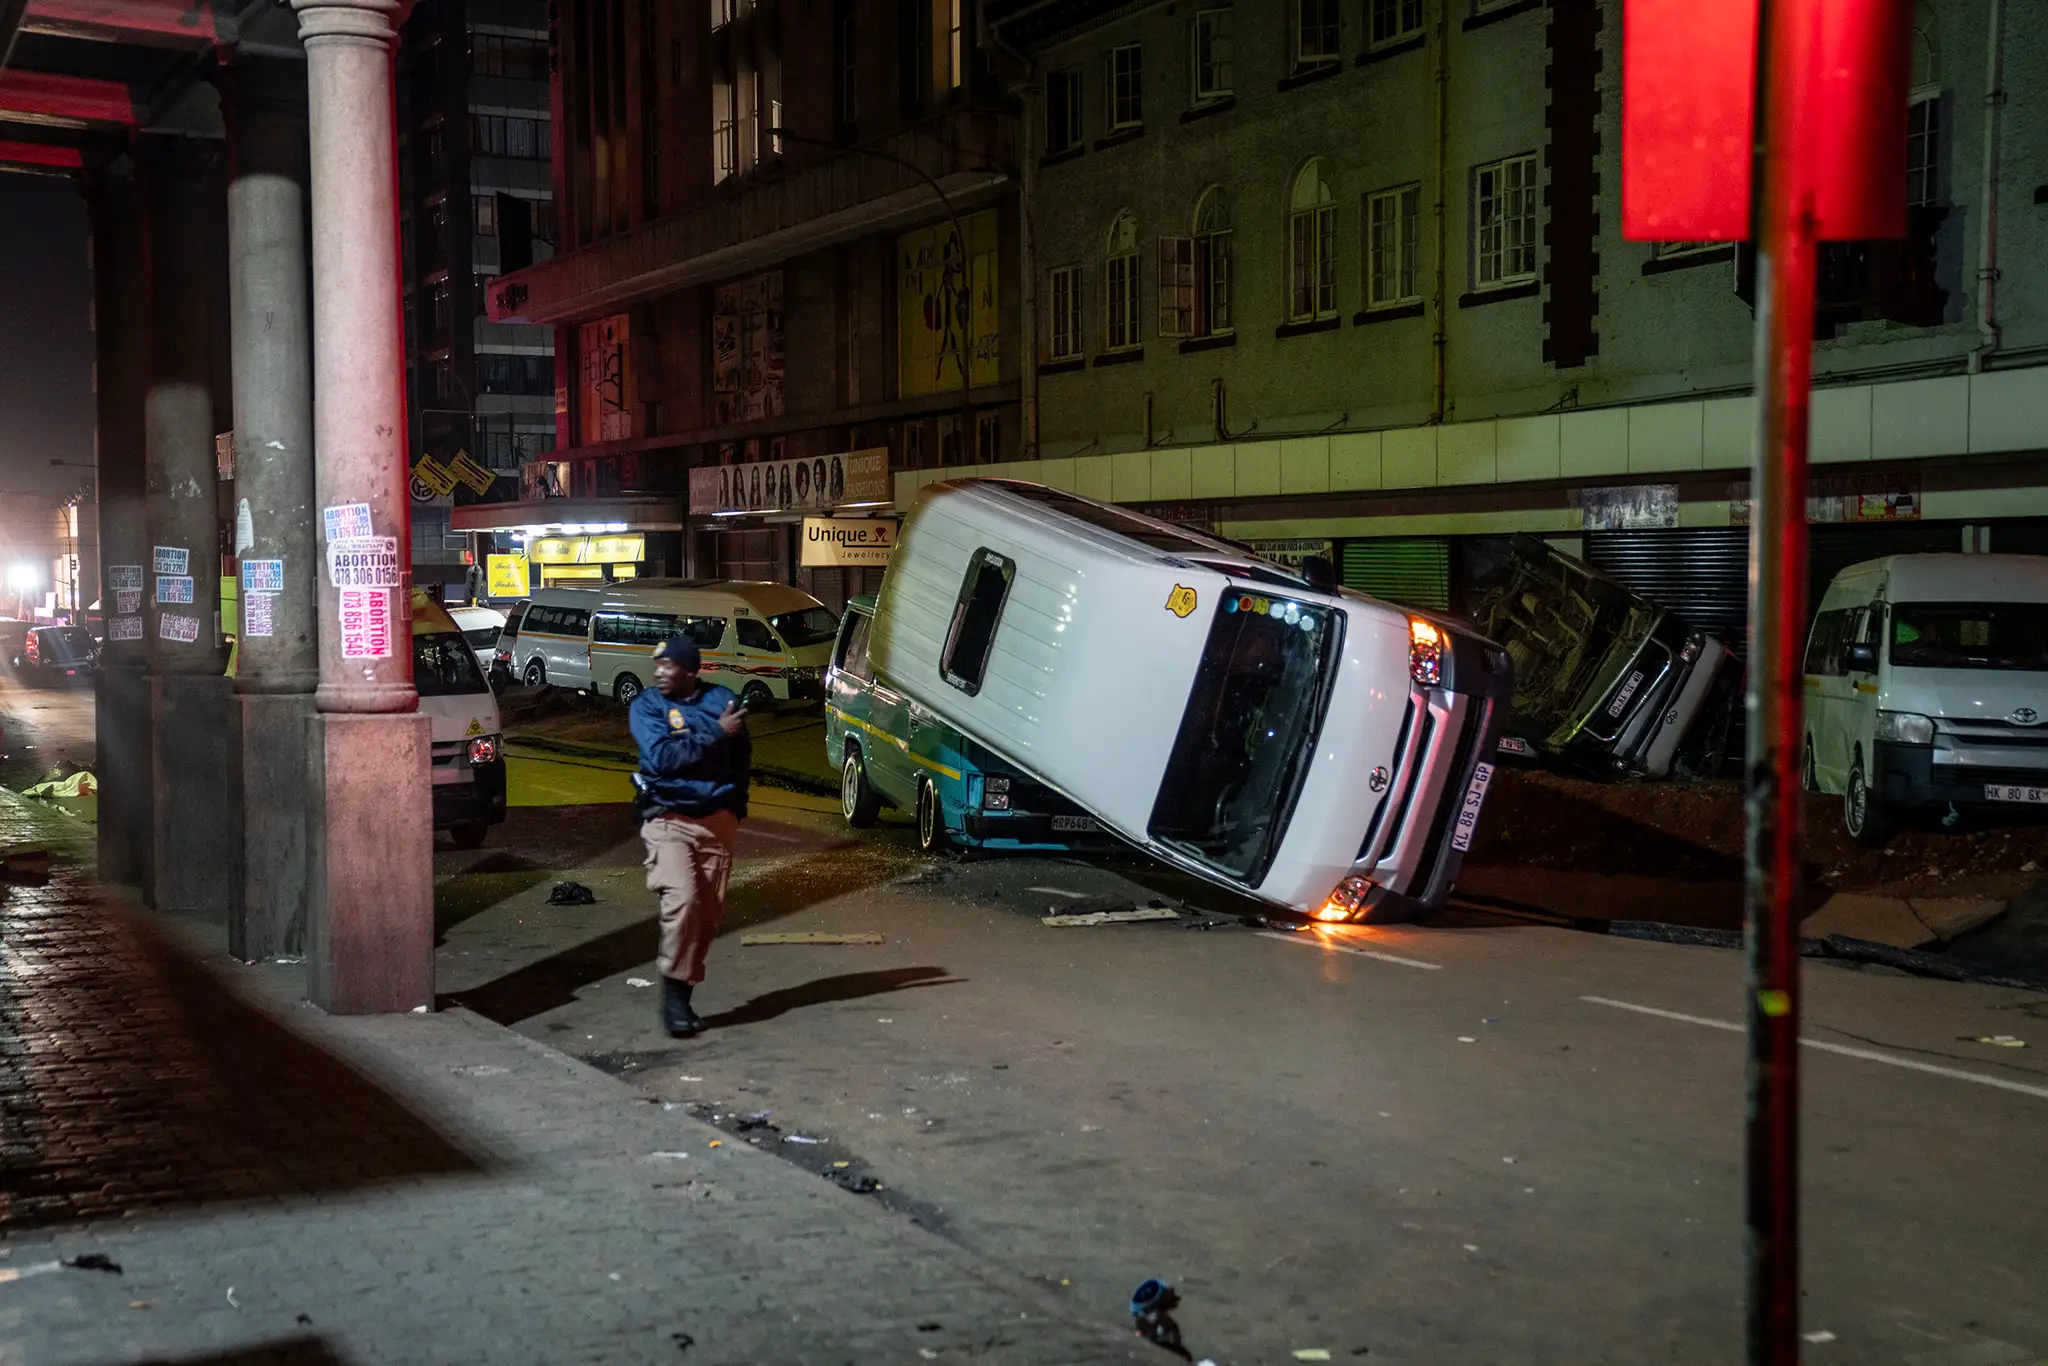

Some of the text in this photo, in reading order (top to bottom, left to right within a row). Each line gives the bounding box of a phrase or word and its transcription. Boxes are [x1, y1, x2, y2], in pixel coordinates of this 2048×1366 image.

[850, 456, 881, 474] UNIQUE
[845, 479, 886, 498] FASHIONS
[326, 506, 368, 520] ABORTION
[808, 526, 867, 546] Unique
[155, 549, 187, 560] ABORTION
[335, 554, 397, 567] ABORTION
[841, 551, 891, 559] Jewellery
[244, 562, 281, 570] ABORTION
[335, 567, 397, 585] 078 306 0156
[264, 595, 273, 634] ABORTION
[343, 591, 364, 656] 073 856 1548
[369, 592, 386, 655] ABORTION
[1632, 672, 1643, 682] HP
[1610, 705, 1621, 716] GP
[1987, 786, 2042, 801] HK 80 GK
[1454, 766, 1490, 849] KL 88 SJ GP
